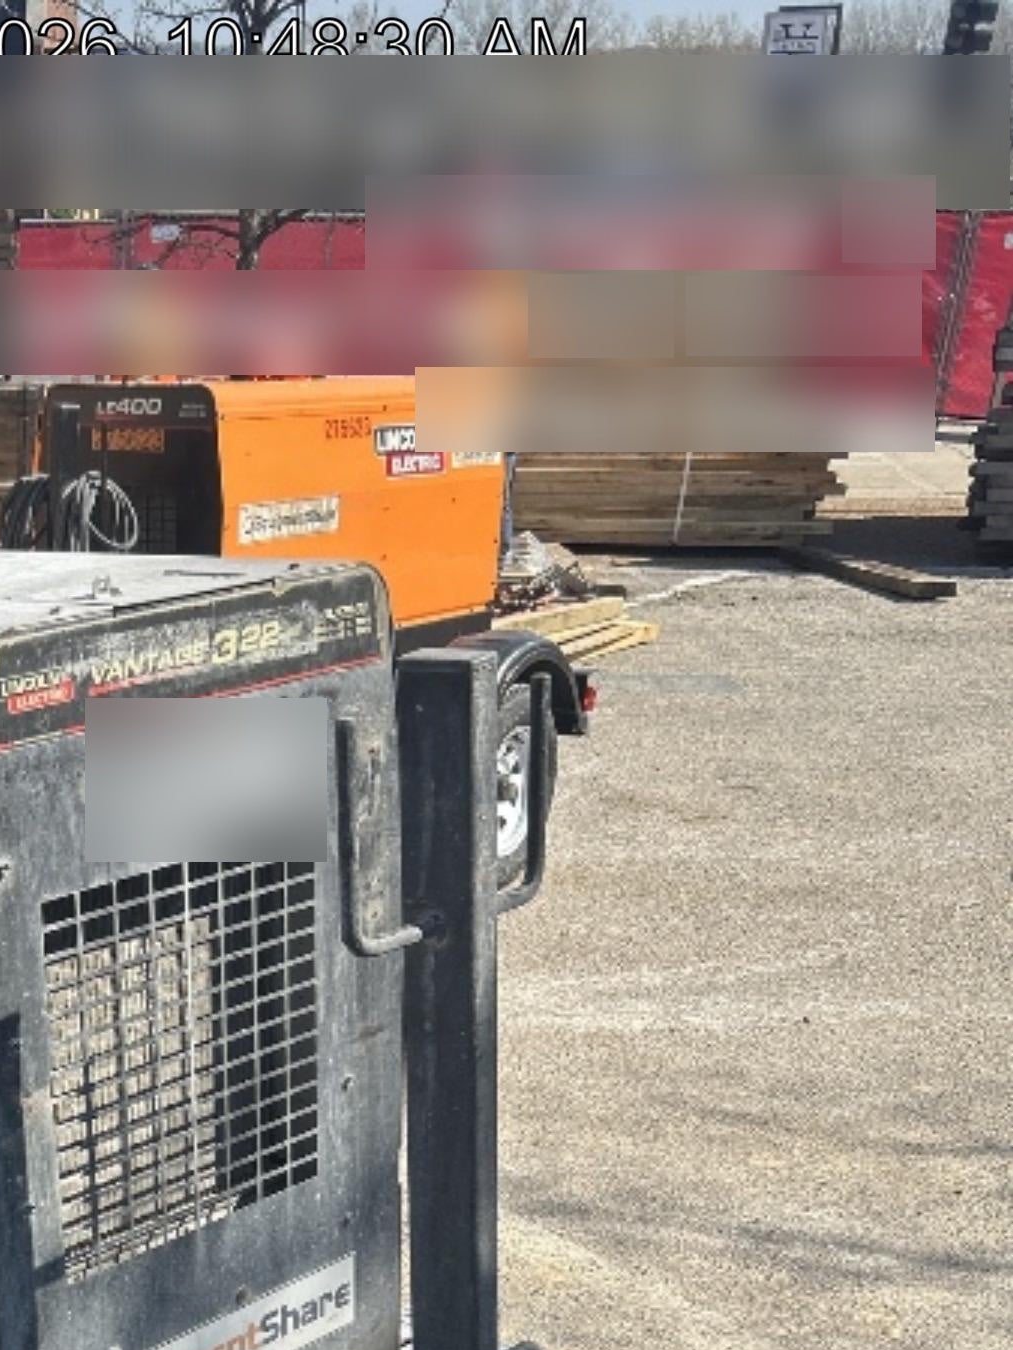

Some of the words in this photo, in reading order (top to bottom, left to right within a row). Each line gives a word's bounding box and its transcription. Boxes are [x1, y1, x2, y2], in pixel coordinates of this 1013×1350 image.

[376, 429, 416, 451] LINCO
[91, 639, 205, 684] VANTAGE
[211, 620, 280, 666] 322
